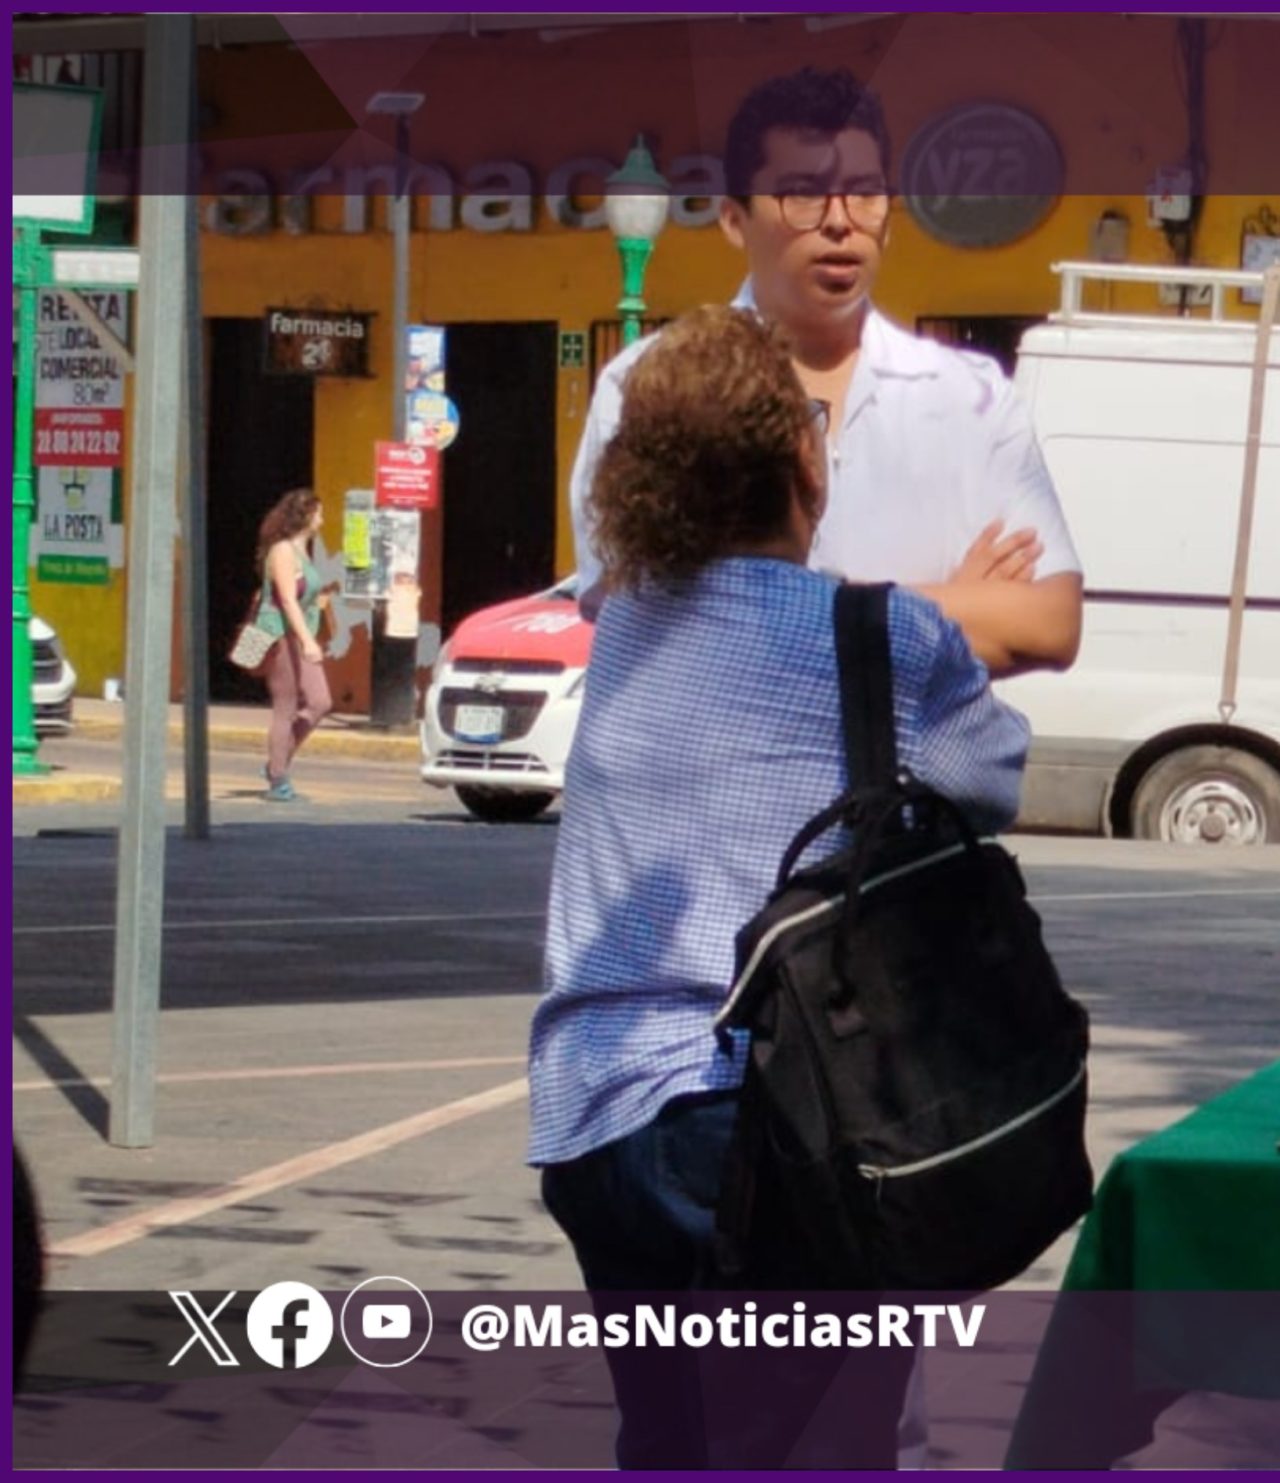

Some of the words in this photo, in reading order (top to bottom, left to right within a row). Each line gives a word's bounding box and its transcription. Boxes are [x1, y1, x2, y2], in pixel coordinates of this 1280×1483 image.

[203, 153, 727, 234] armaca
[927, 147, 1028, 213] yza
[41, 292, 120, 321] RETA
[40, 356, 120, 380] COMERCIAL
[65, 515, 104, 541] POSTA
